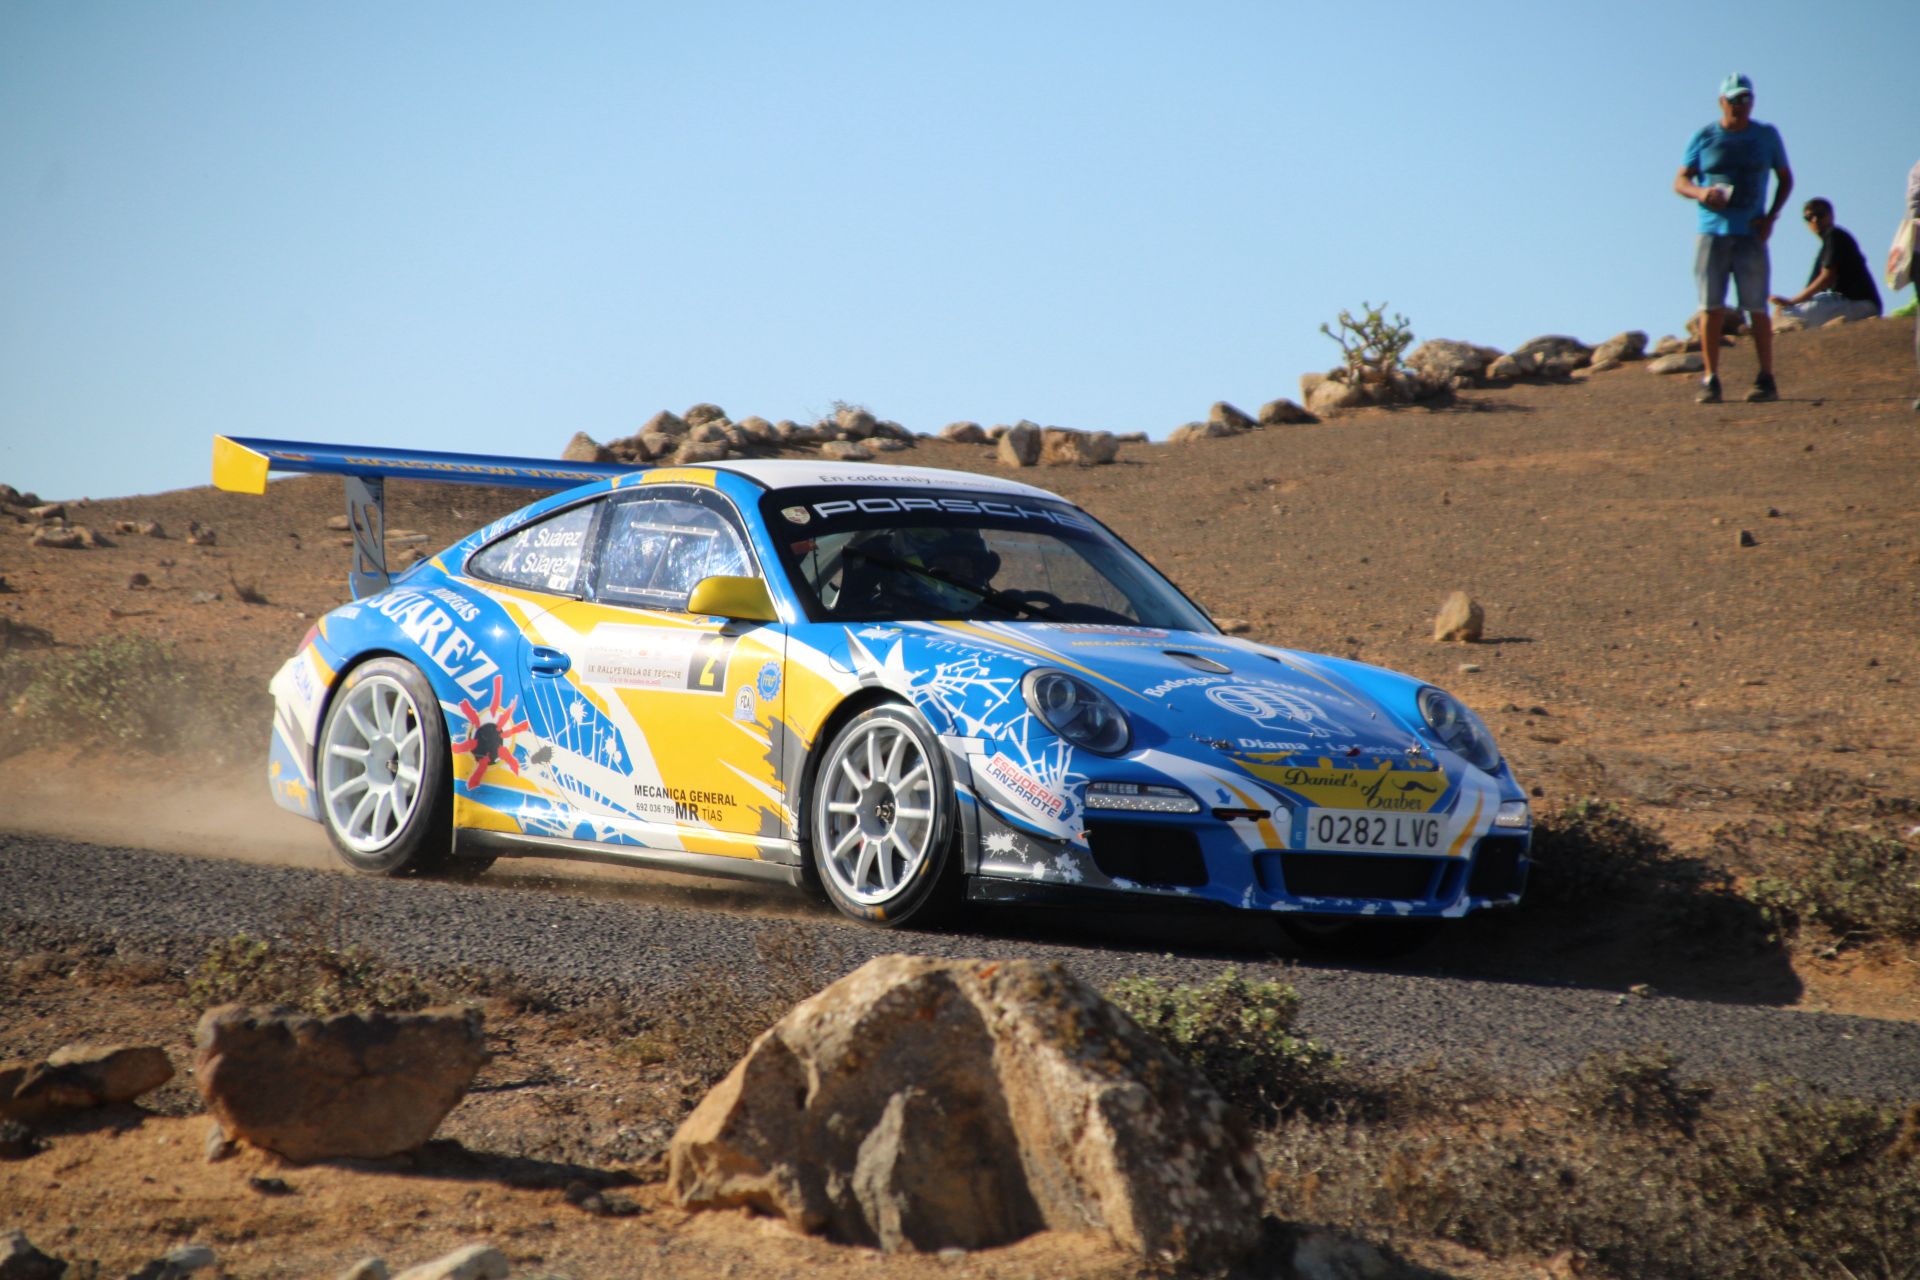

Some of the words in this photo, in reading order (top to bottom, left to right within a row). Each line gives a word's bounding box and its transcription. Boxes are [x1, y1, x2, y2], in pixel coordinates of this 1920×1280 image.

[818, 475, 843, 483] En
[812, 497, 1094, 532] PORSCHE
[534, 527, 582, 548] Suárez
[366, 590, 500, 700] SUAREZ
[699, 637, 724, 686] 2
[1143, 677, 1226, 698] Bodegas
[1238, 738, 1310, 750] Diama
[1284, 768, 1359, 788] Daniel's
[634, 784, 686, 801] MECANICA
[689, 790, 737, 807] GENERAL
[986, 763, 1058, 818] LANZAROTE
[649, 804, 661, 813] 036
[675, 802, 700, 821] MR
[1317, 814, 1388, 846] 0282
[1395, 818, 1439, 848] LVG
